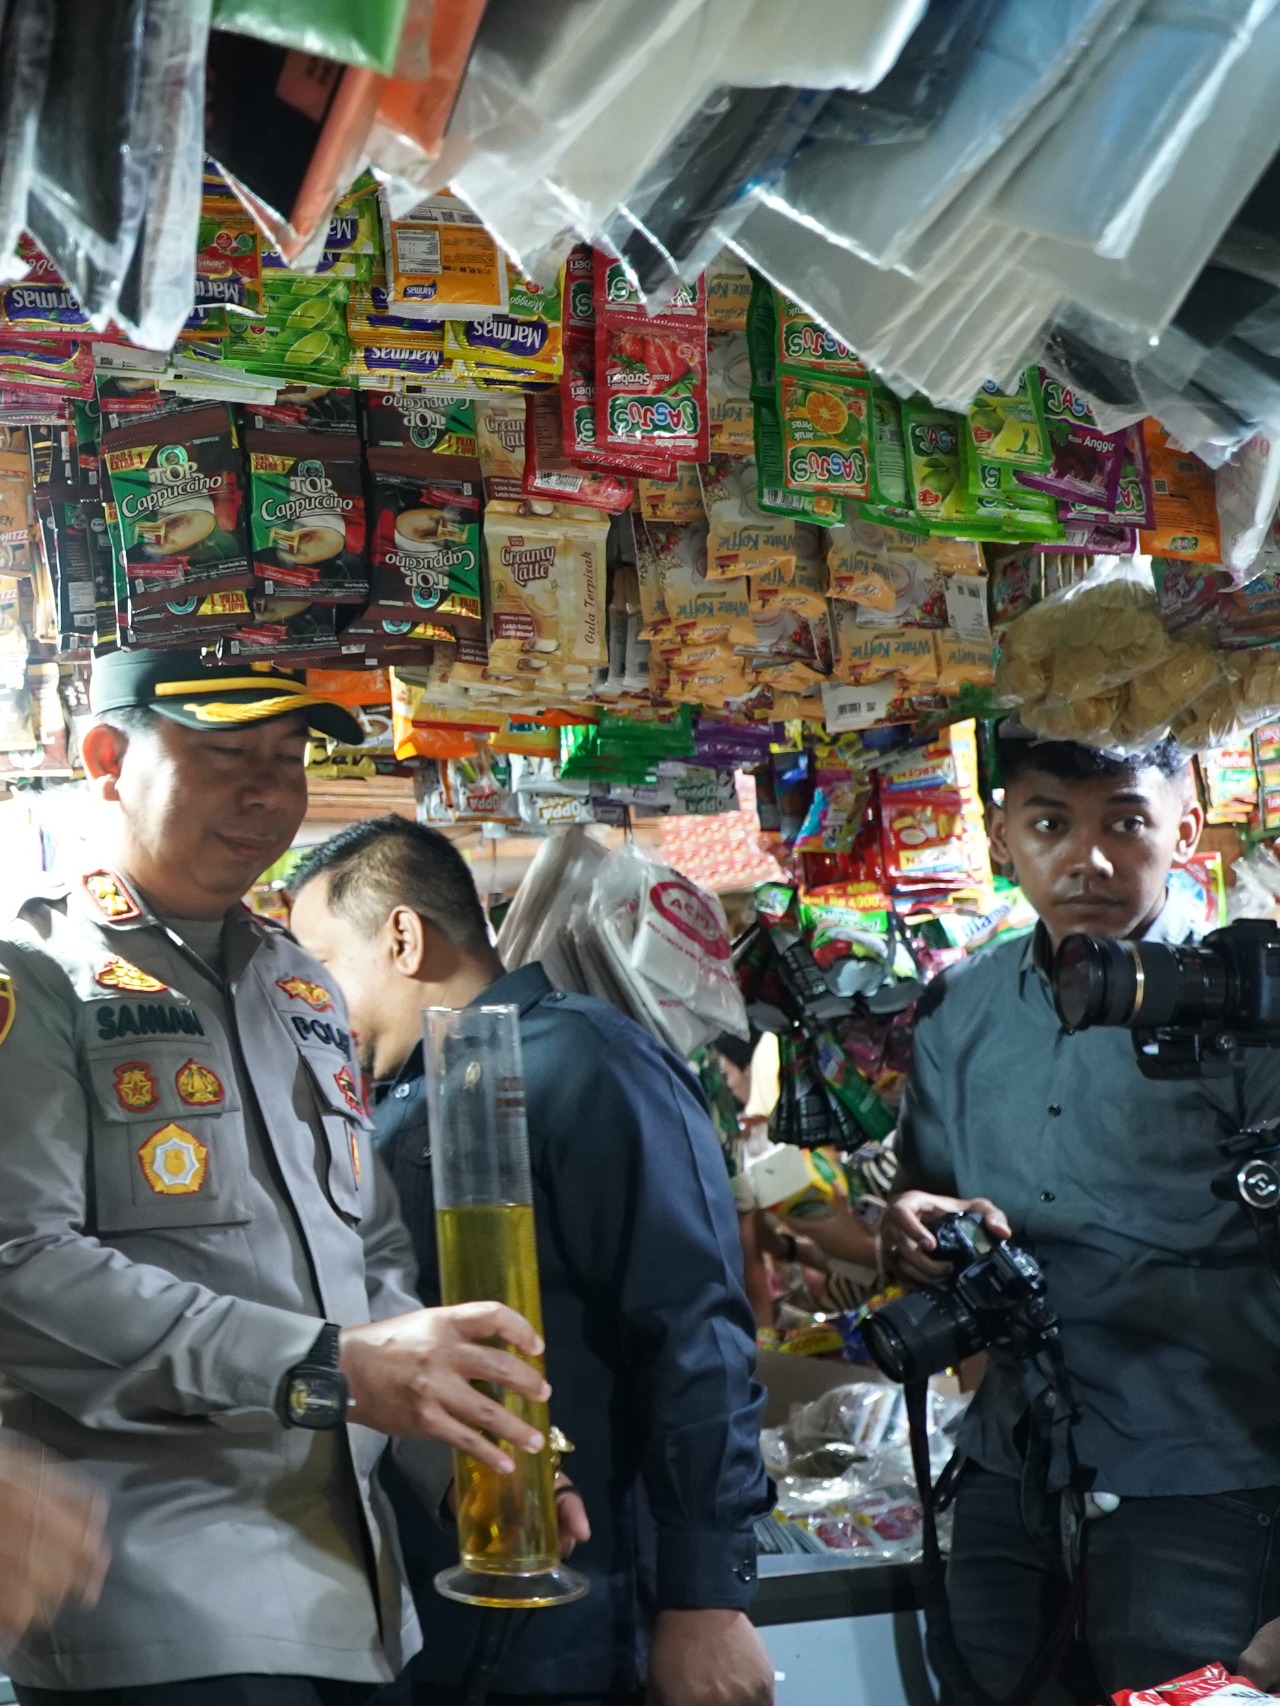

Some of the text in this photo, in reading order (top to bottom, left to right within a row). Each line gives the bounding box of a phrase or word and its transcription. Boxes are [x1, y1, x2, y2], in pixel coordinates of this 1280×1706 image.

[195, 276, 240, 301] Mari
[11, 288, 88, 315] arimas
[472, 319, 543, 349] Marimas
[607, 373, 651, 387] Stroberi
[403, 410, 446, 430] TOP
[486, 415, 525, 433] Cream
[612, 401, 695, 431] JASJUS
[148, 461, 200, 485] TOP
[793, 449, 866, 483] JASJUS
[120, 475, 222, 519] Cappuccino
[289, 476, 334, 494] TOP
[260, 493, 354, 522] Cappuccino
[385, 548, 476, 571] Cappuccino
[500, 546, 556, 566] Creamy
[404, 572, 449, 591] TOP
[511, 563, 550, 587] Latte
[584, 551, 598, 610] Terpisah
